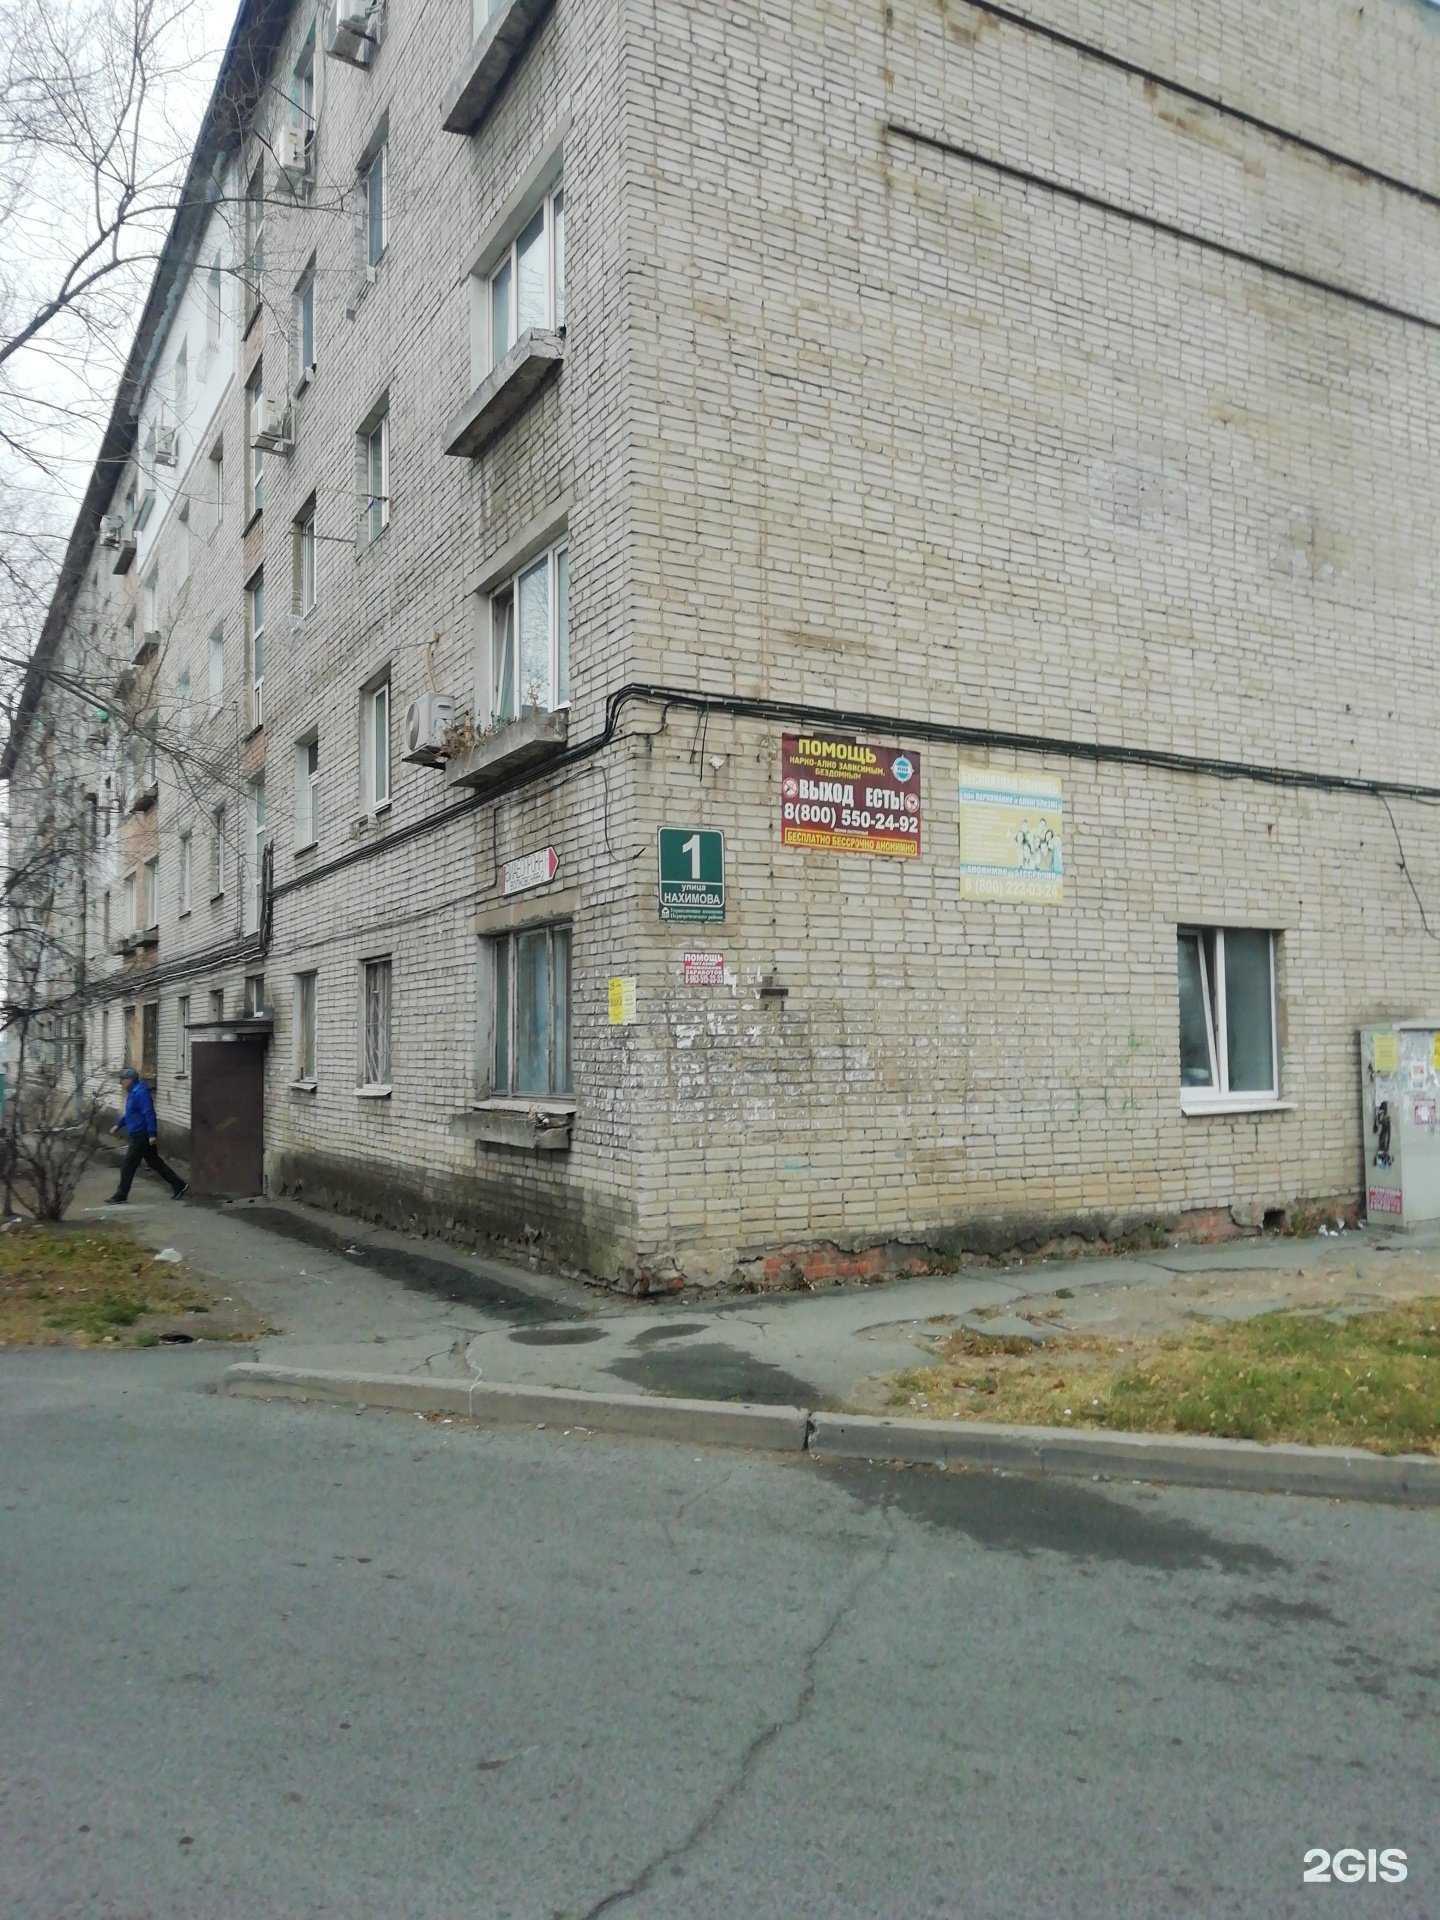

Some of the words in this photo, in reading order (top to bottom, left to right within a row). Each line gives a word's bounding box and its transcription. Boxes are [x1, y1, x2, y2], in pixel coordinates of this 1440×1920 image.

[798, 739, 877, 764] ПОМОЩЬ
[799, 779, 854, 808] ВЫХОД
[865, 787, 905, 811] ЕСТЬ!
[784, 802, 837, 829] 8(800)
[841, 809, 919, 833] 550-24-92
[787, 831, 831, 845] БЕСПЛАТНО
[832, 836, 875, 849] БЕССРОЧНО
[682, 834, 701, 880] 1
[664, 892, 720, 905] НАХИМОВА
[681, 884, 706, 892] улица
[685, 953, 722, 961] ПОМОЩЬ
